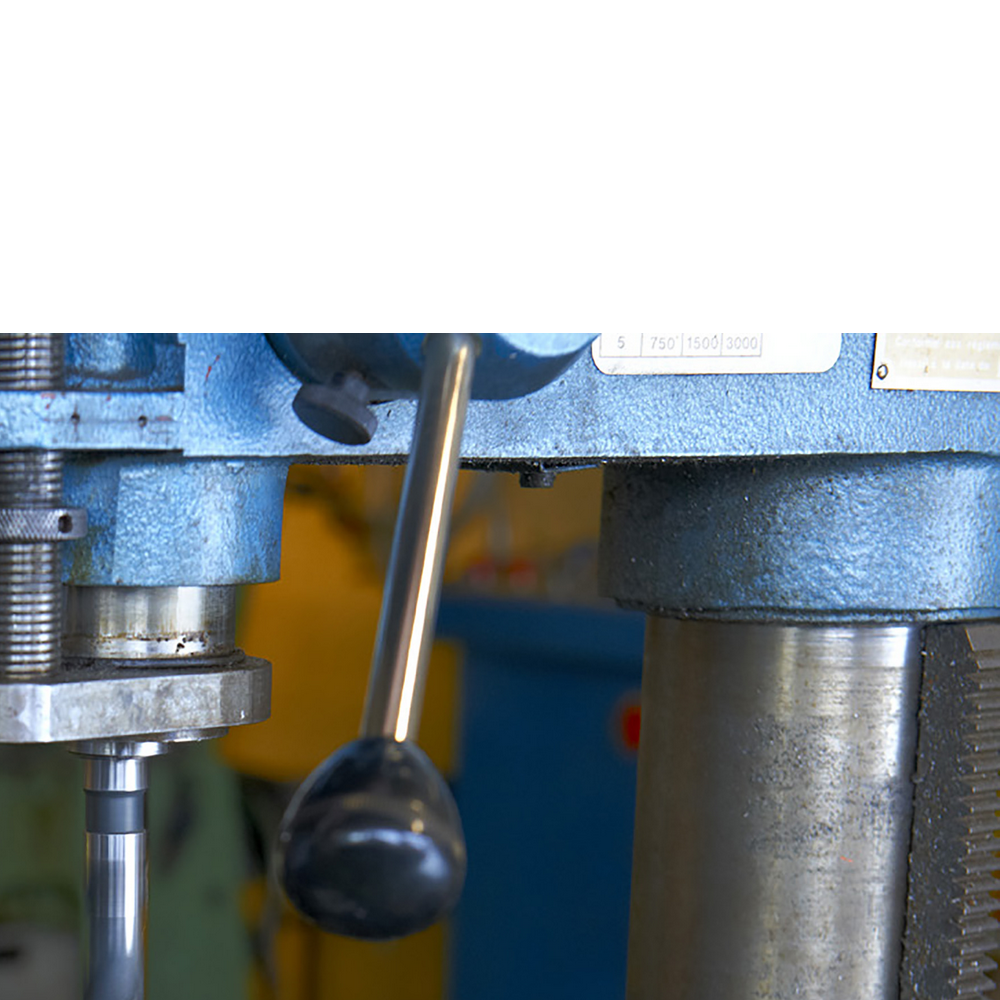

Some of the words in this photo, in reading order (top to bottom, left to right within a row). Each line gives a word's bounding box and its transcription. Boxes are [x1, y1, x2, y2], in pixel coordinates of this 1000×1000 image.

[617, 336, 626, 349] 5
[650, 336, 676, 350] 750
[687, 336, 719, 350] 1500
[726, 336, 758, 350] 3000
